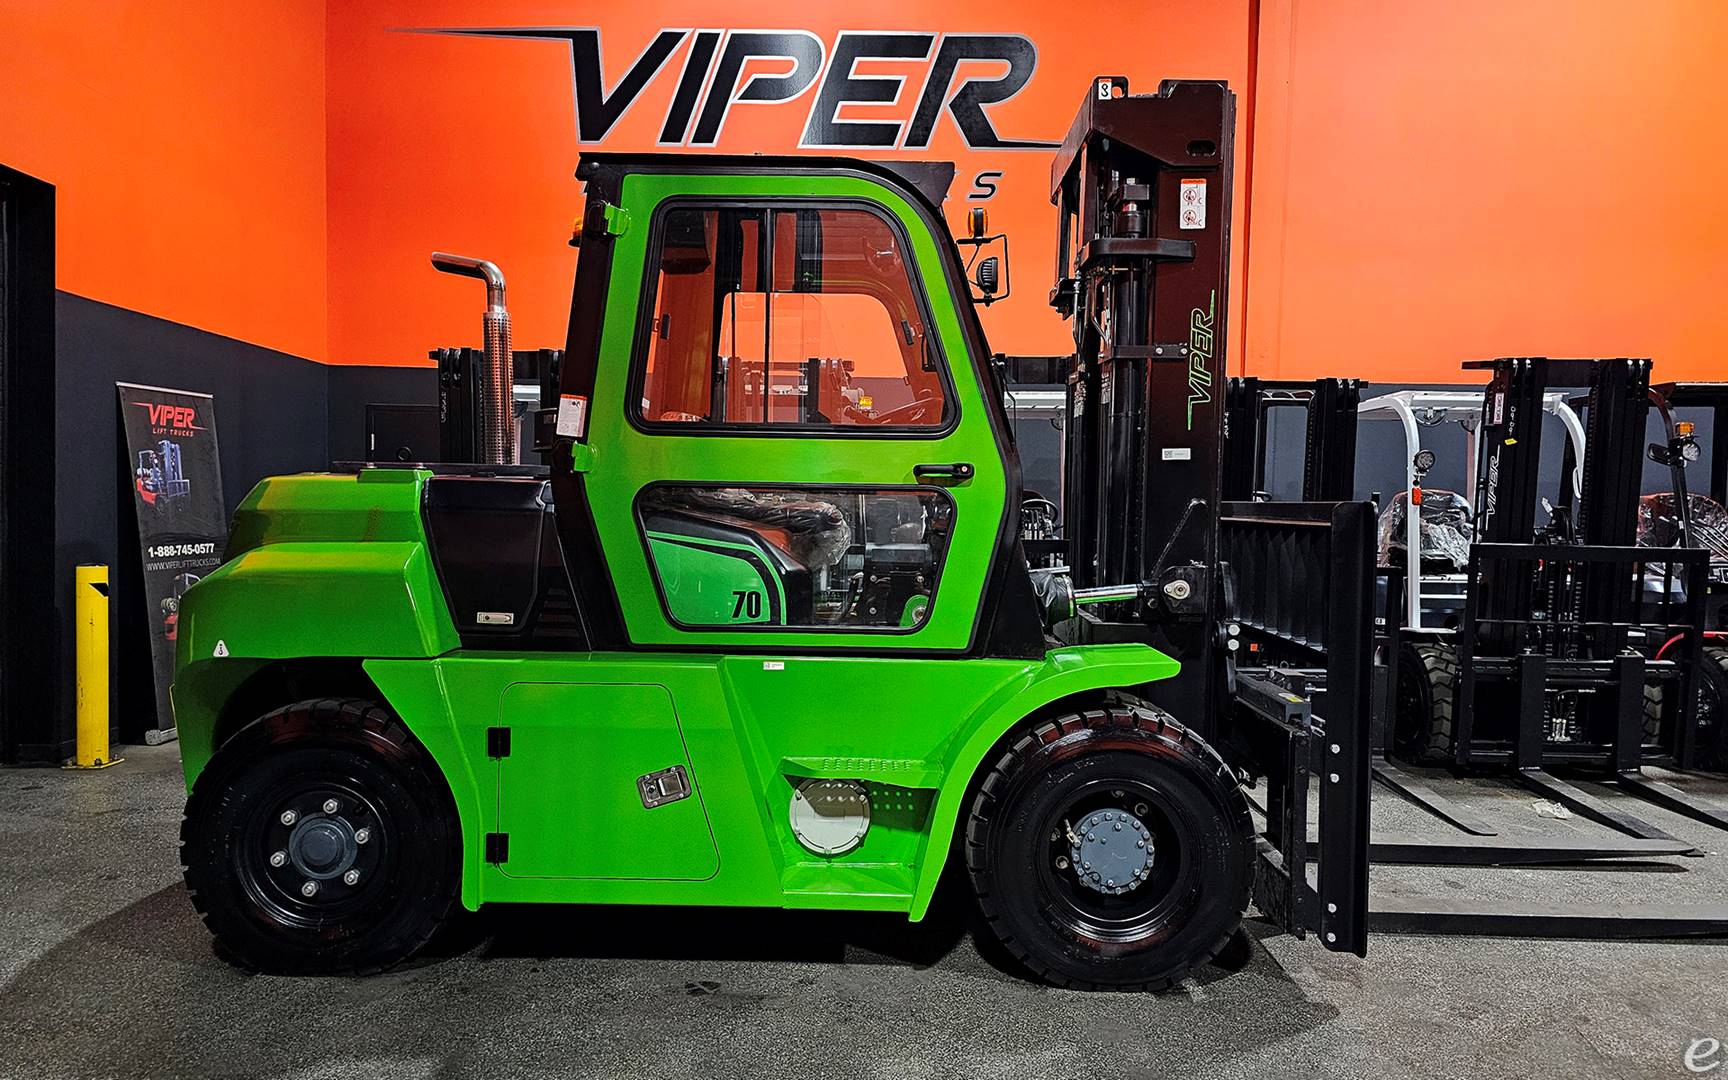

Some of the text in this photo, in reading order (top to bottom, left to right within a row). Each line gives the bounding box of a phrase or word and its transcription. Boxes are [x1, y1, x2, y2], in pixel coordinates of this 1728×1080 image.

[392, 27, 1062, 150] VIPER
[1188, 290, 1214, 430] VIPER
[134, 402, 205, 429] VIPER
[169, 429, 194, 437] TRUCKS
[1486, 446, 1500, 529] VIPER
[147, 543, 214, 558] 1-888-745-0577
[732, 590, 761, 619] 70
